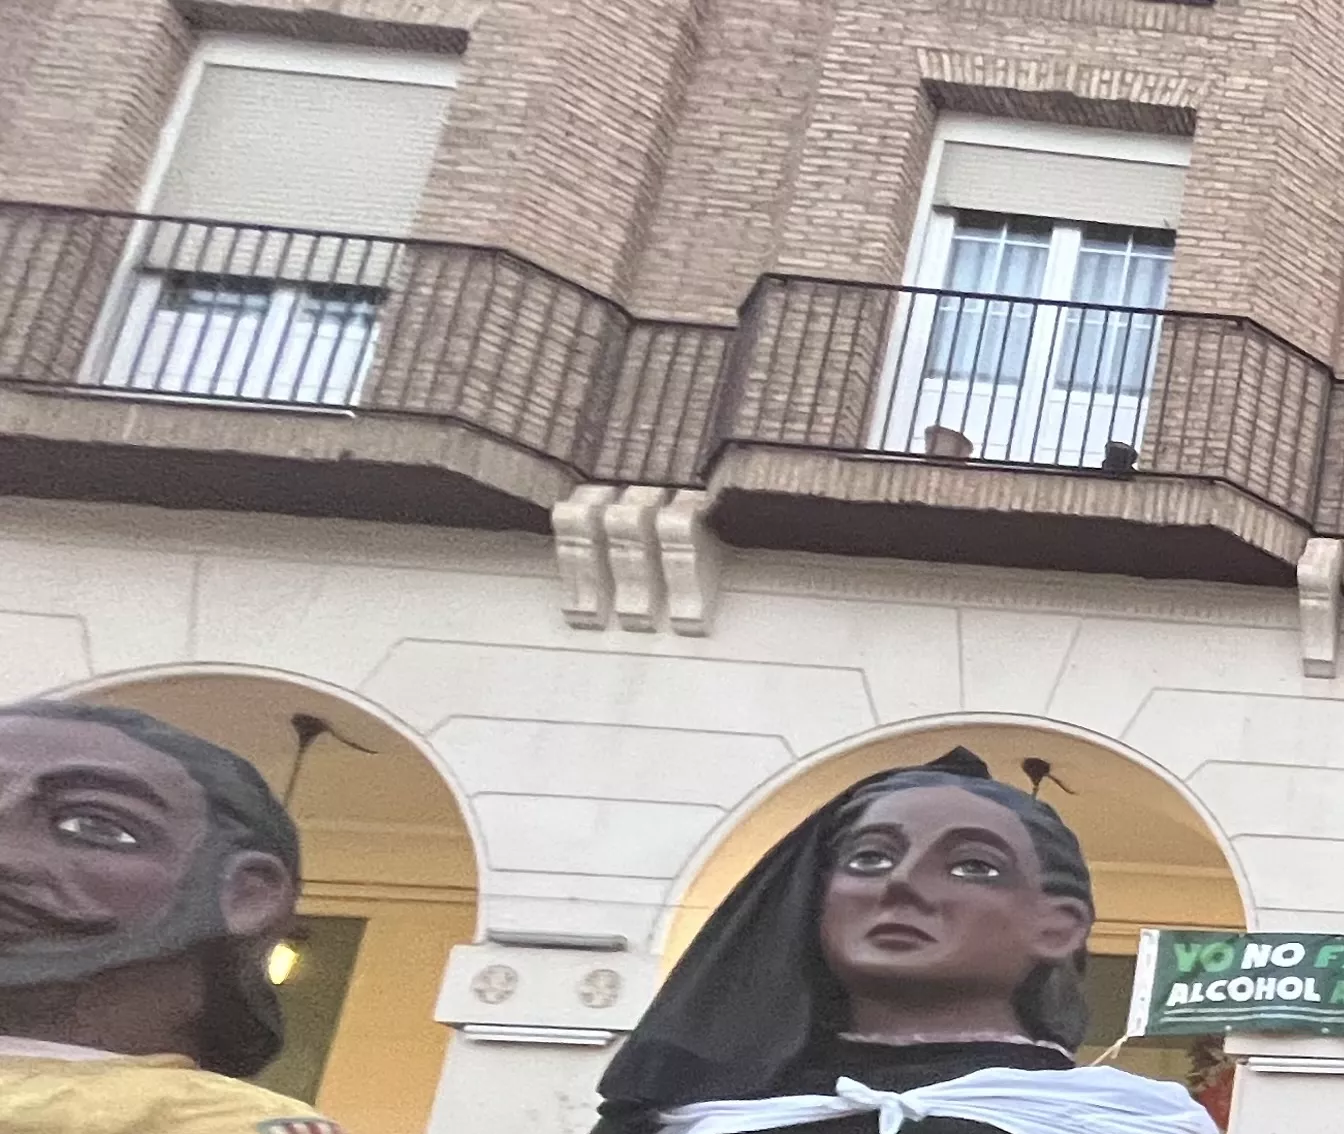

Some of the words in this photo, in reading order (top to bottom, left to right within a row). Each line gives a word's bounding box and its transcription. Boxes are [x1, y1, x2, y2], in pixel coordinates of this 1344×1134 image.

[1173, 943, 1236, 973] YO
[1240, 942, 1305, 970] NO
[1165, 977, 1321, 1008] ALCOHOL
